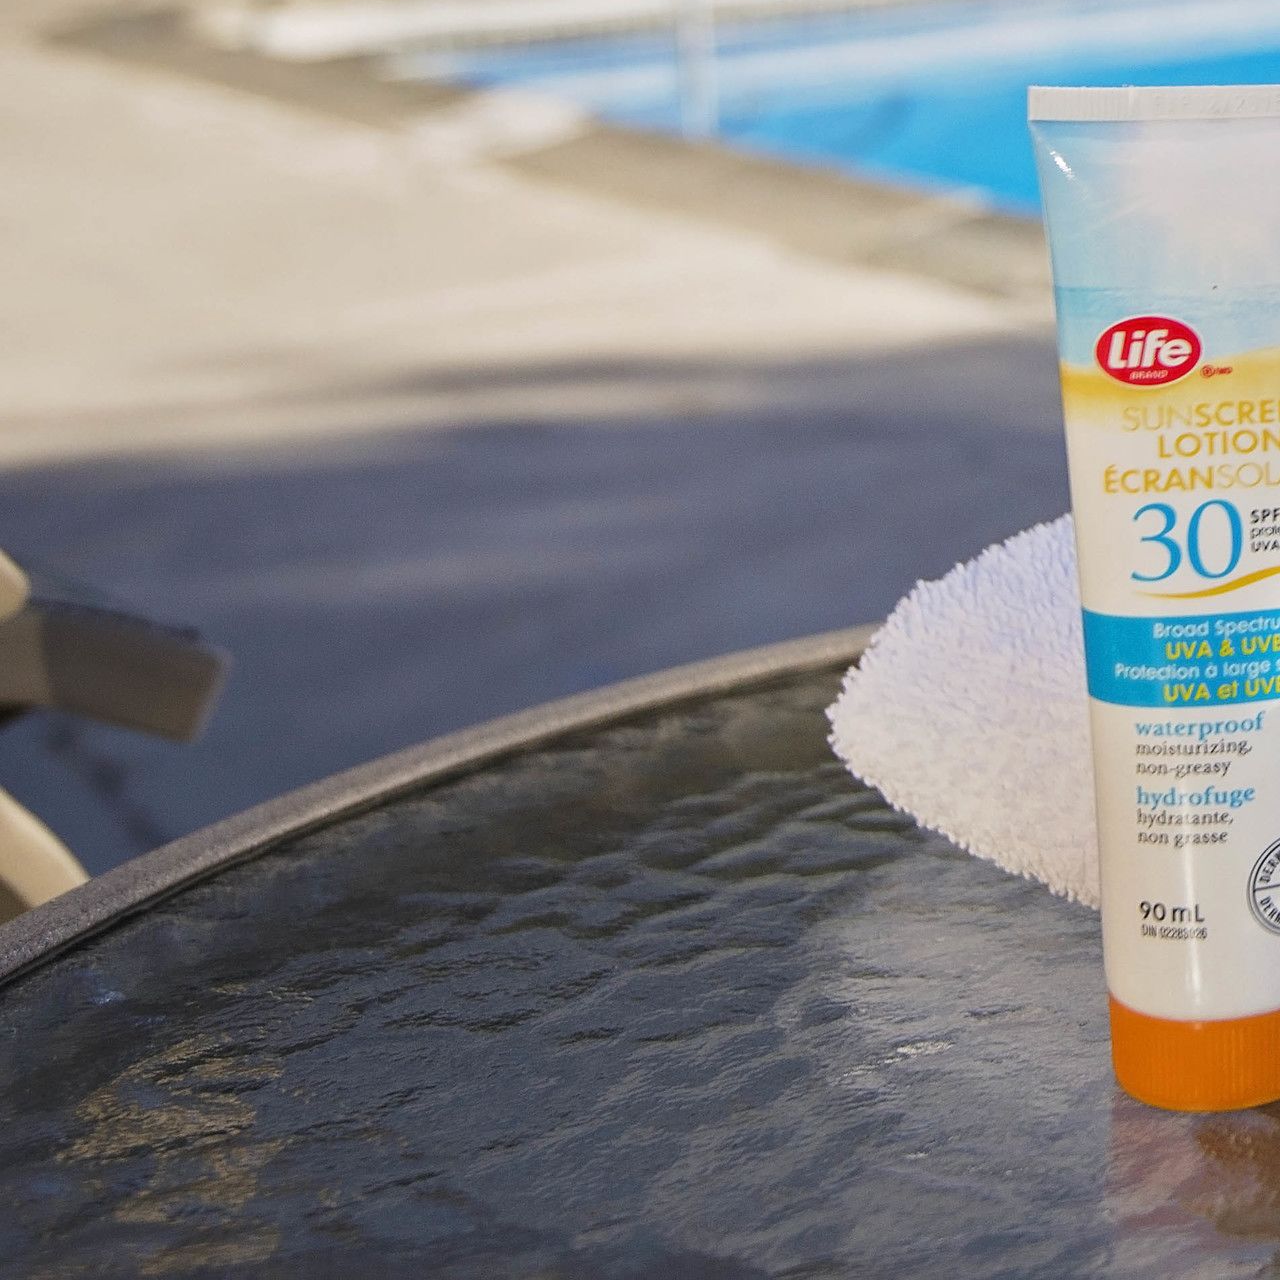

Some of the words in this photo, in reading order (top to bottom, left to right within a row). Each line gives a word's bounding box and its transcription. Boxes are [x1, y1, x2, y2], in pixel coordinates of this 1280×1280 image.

[1107, 329, 1193, 369] Life
[1250, 507, 1280, 524] SPF
[1130, 498, 1244, 582] 30
[1250, 539, 1280, 553] UVA
[1153, 621, 1209, 639] Broad
[1165, 640, 1213, 660] UVA
[1219, 638, 1235, 657] &
[1114, 662, 1200, 681] Protection
[1204, 662, 1218, 679] à
[1223, 660, 1271, 680] large
[1162, 683, 1211, 703] UVA
[1217, 680, 1239, 699] et
[1135, 711, 1265, 742] waterproof
[1136, 760, 1232, 779] non-greasy
[1136, 785, 1256, 810] hydrofuge
[1137, 832, 1169, 846] non
[1173, 831, 1228, 848] grasse
[1140, 901, 1166, 922] 90
[1171, 903, 1206, 923] mL
[1141, 924, 1158, 937] DIN
